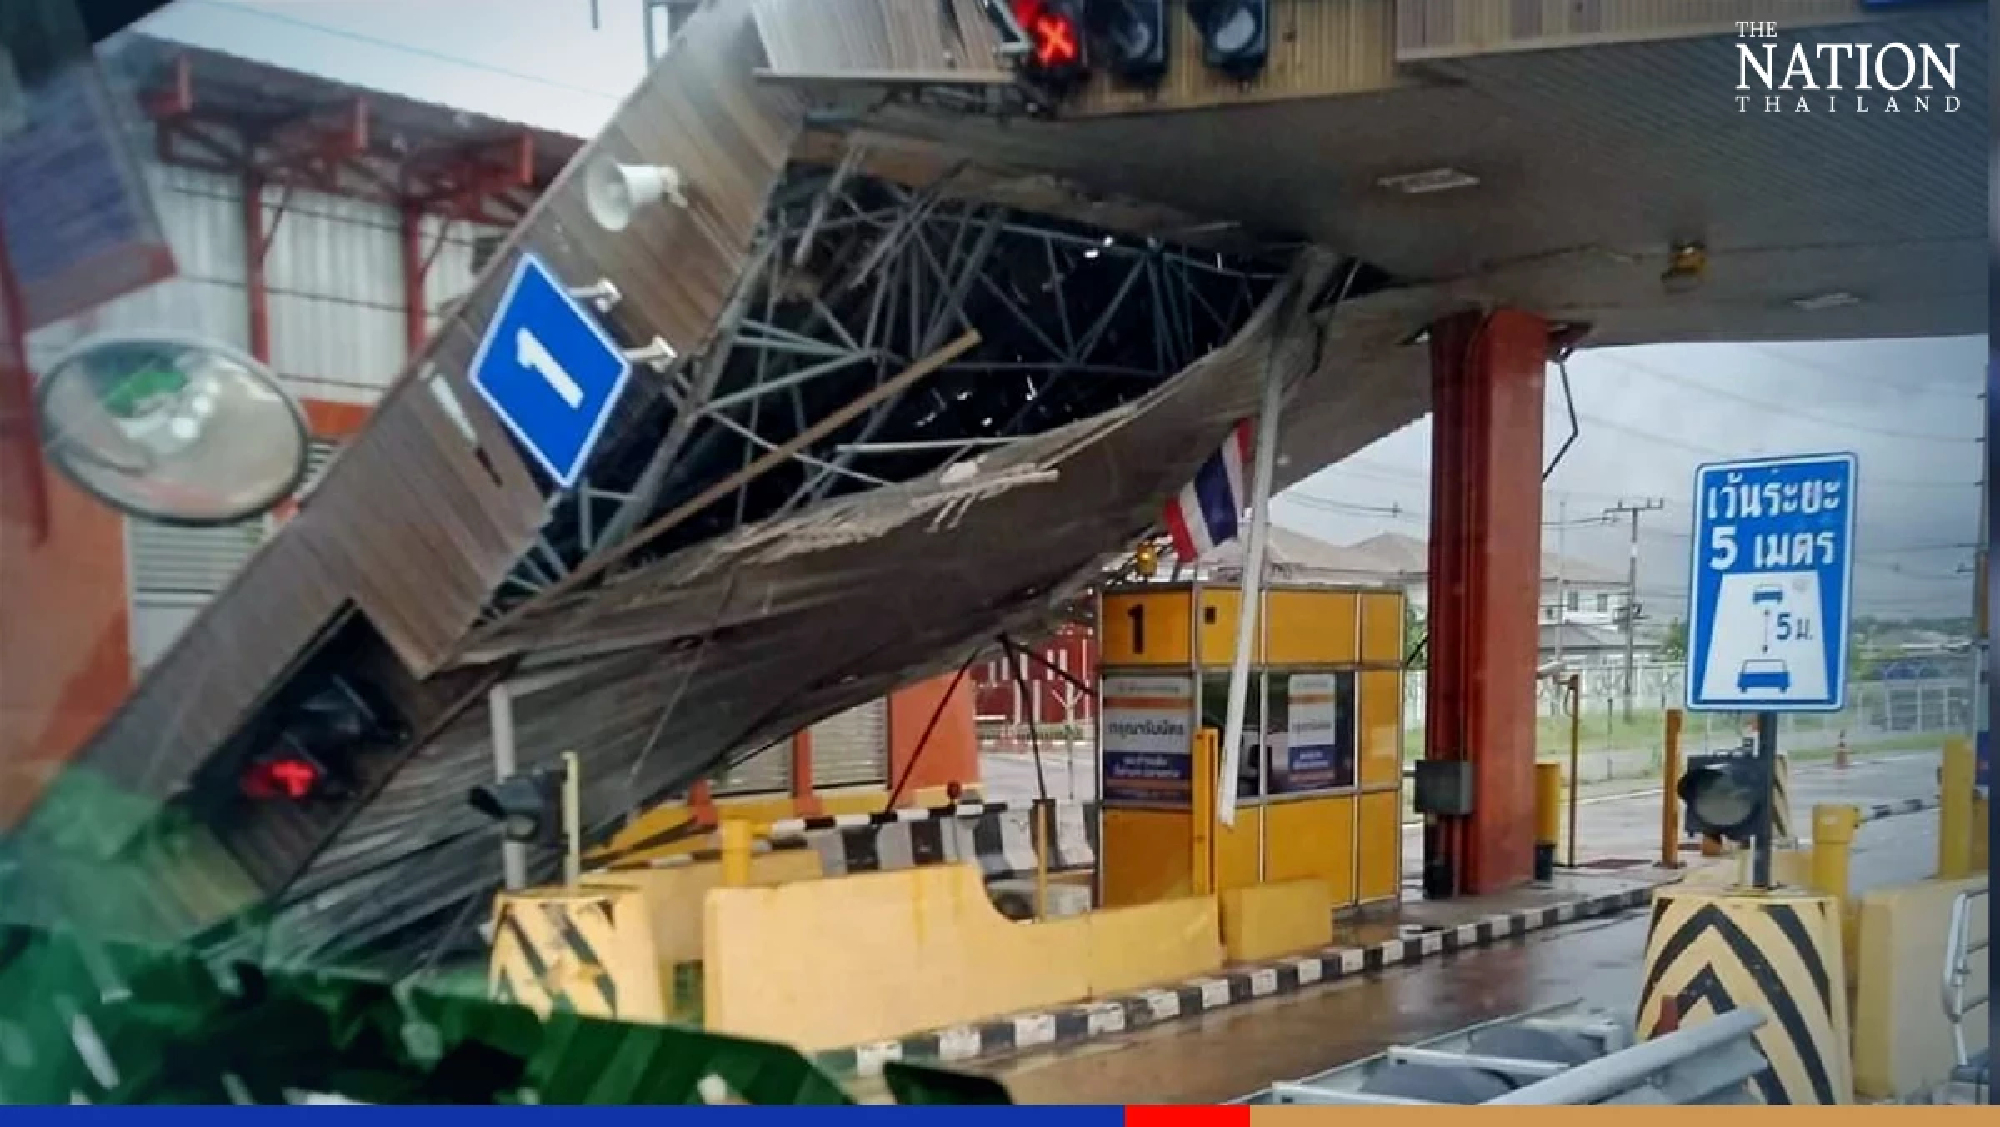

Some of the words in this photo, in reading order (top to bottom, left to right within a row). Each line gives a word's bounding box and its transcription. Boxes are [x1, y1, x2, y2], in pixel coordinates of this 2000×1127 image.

[516, 327, 584, 409] 1
[1707, 471, 1841, 519] เว้นระยะ
[1708, 526, 1738, 570] 5
[1753, 532, 1836, 568] เมตร
[1127, 603, 1145, 654] 1
[1776, 612, 1792, 640] 5
